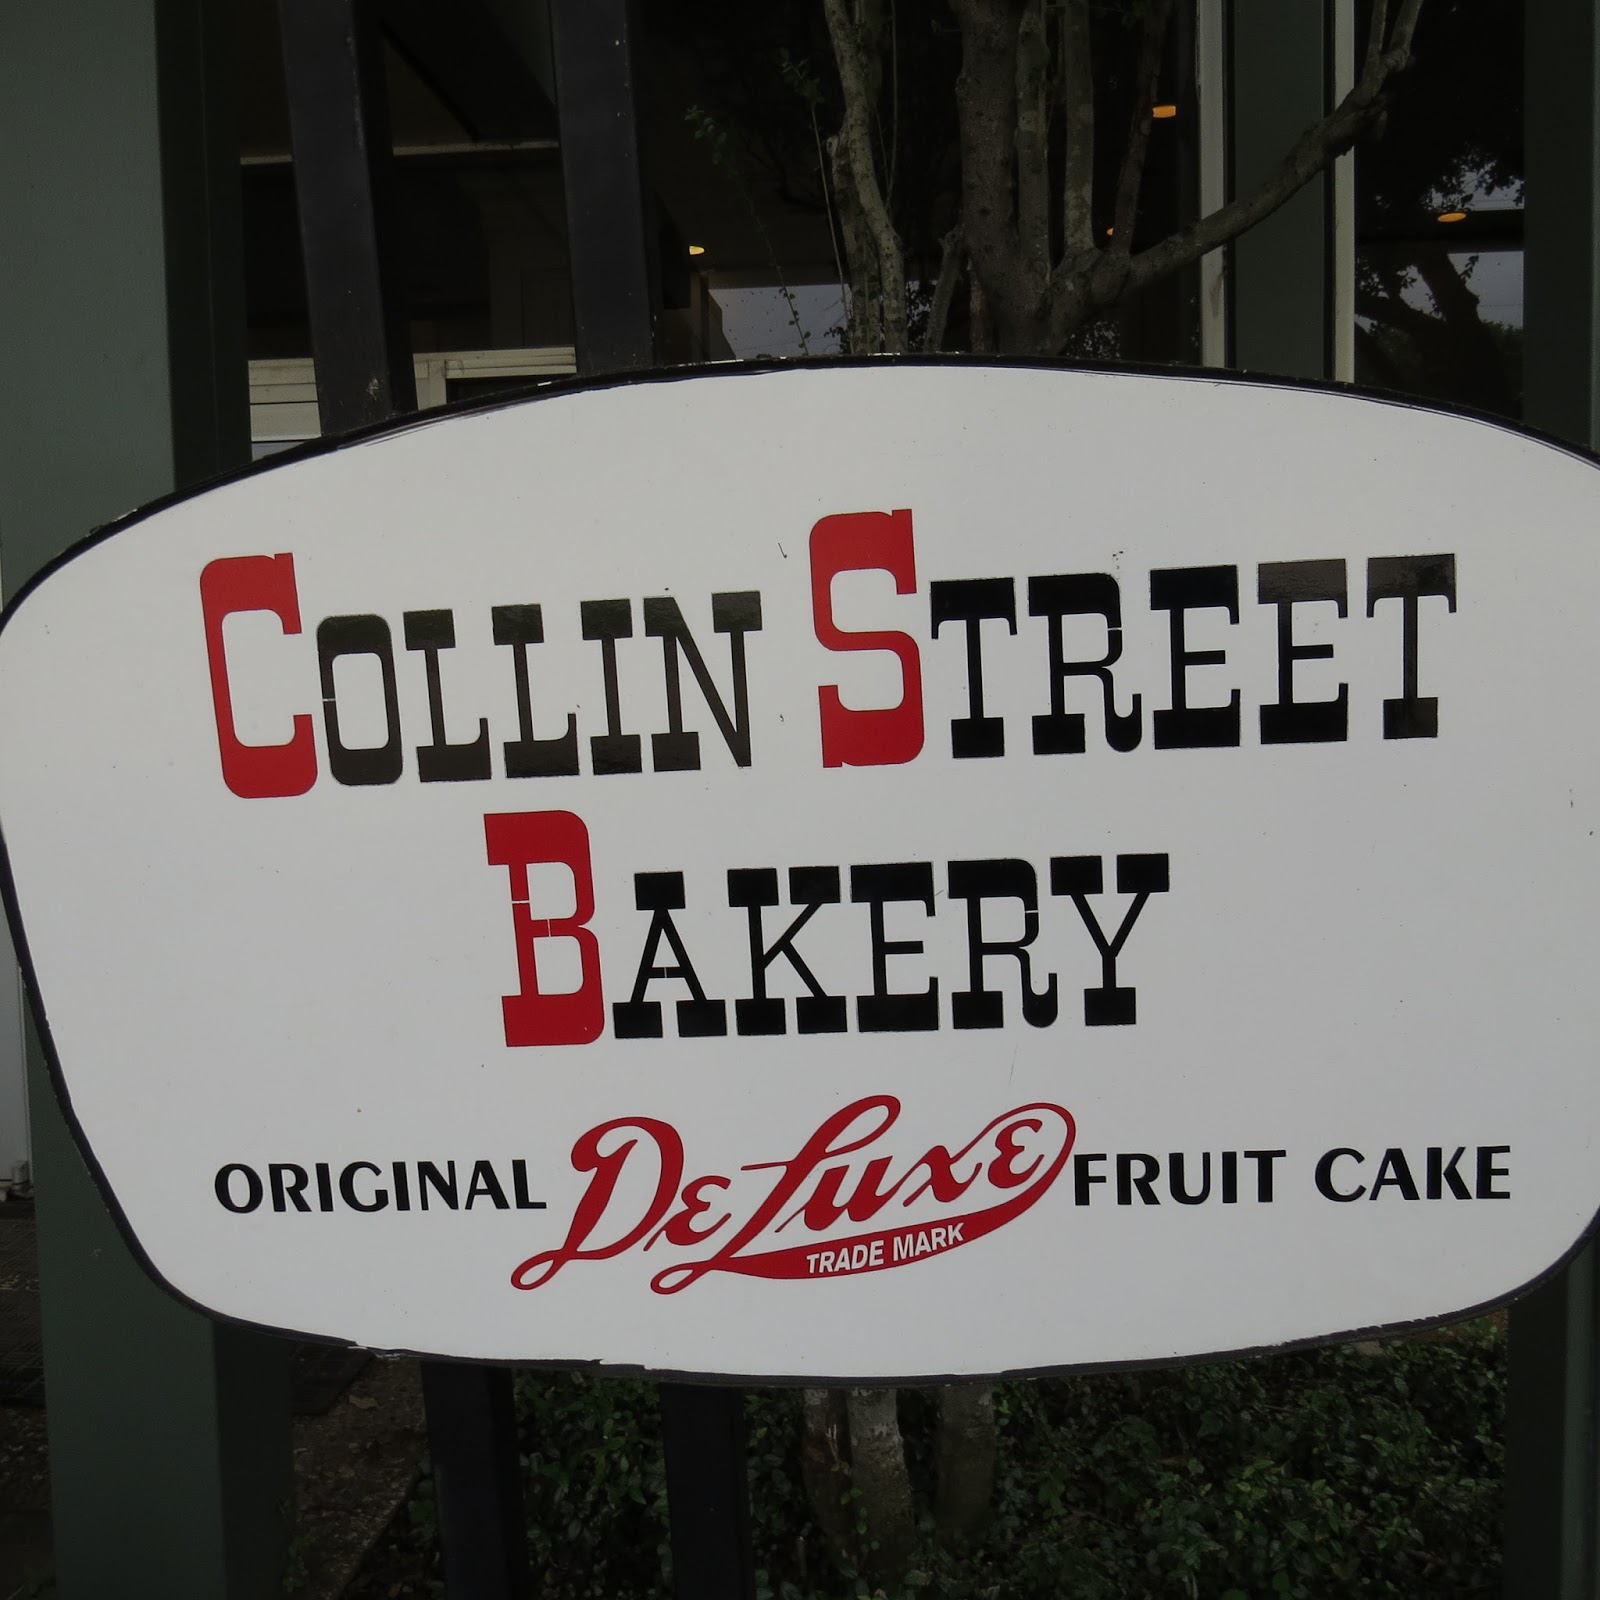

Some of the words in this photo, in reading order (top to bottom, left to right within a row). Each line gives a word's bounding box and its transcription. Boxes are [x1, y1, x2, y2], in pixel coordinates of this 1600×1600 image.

[200, 552, 762, 799] COLLIN
[809, 509, 1457, 768] STREET
[483, 810, 1170, 1047] BAKERY
[215, 1159, 547, 1214] ORIGINAL
[1074, 1150, 1286, 1206] FRUIT
[1315, 1145, 1510, 1202] CAKE
[806, 1239, 884, 1275] TRADE
[892, 1222, 965, 1260] MARK
